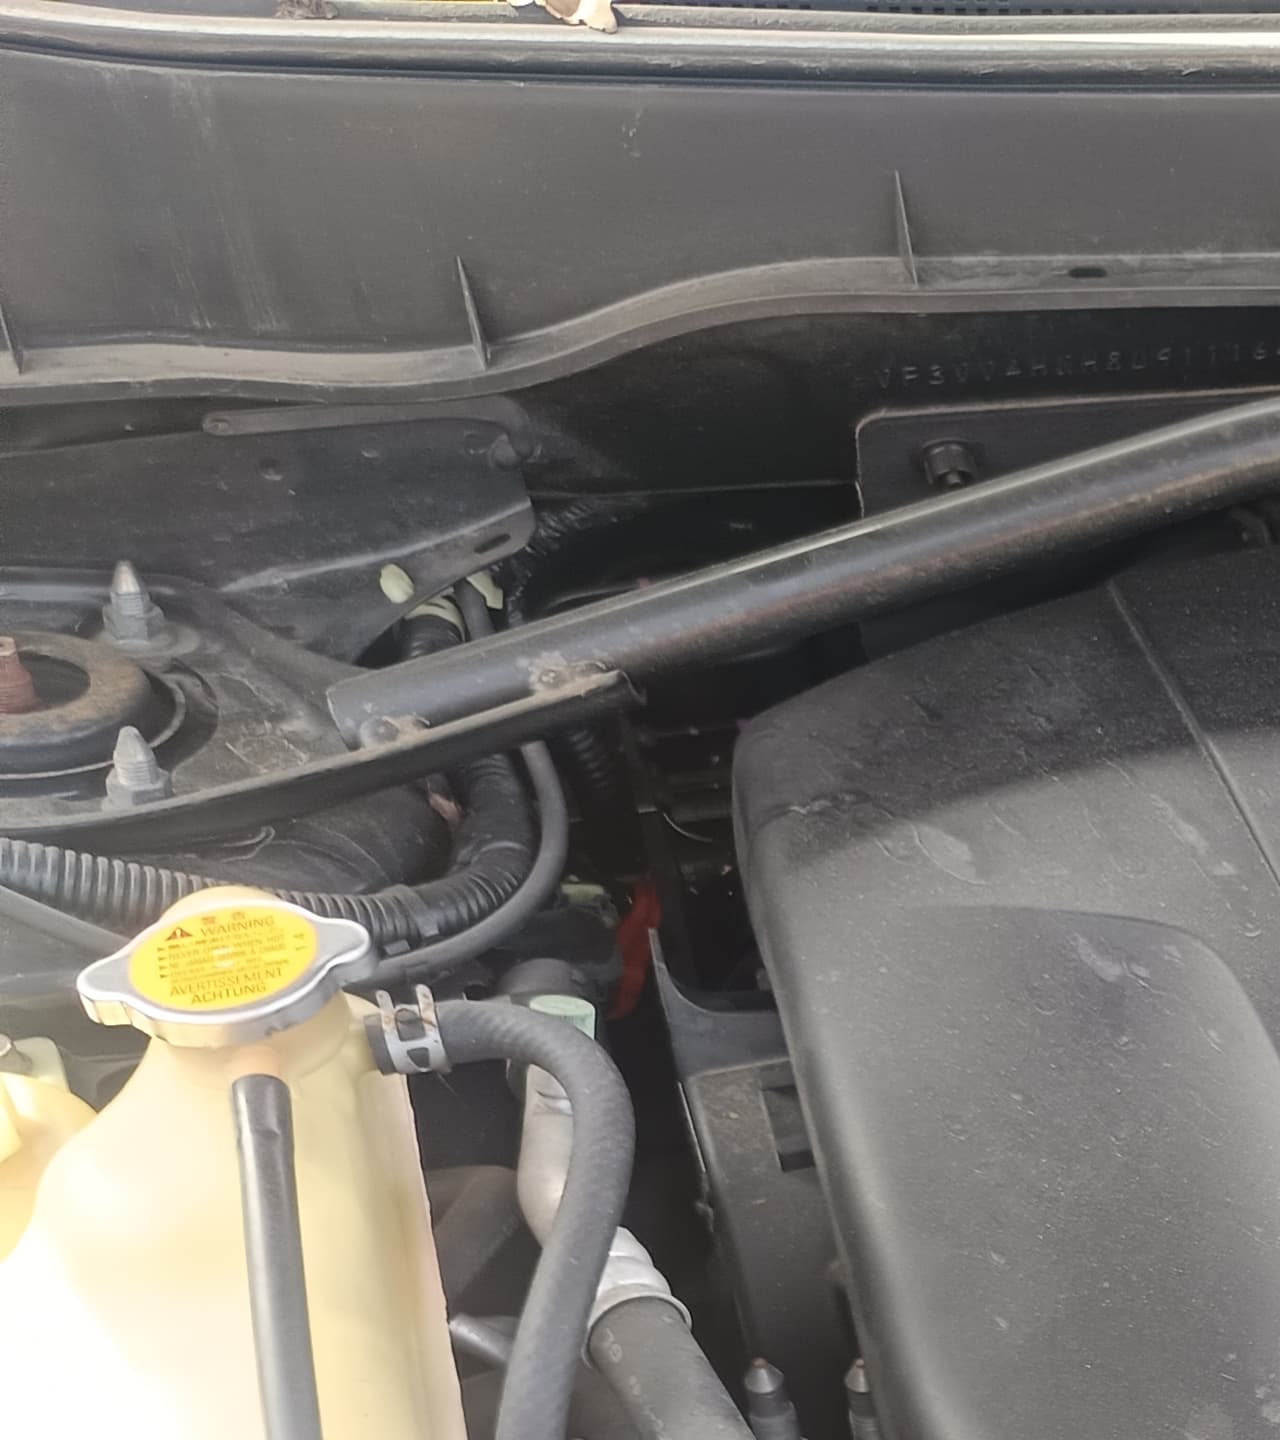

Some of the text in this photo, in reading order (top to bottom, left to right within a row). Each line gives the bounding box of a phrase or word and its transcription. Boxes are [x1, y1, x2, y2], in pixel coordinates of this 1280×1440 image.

[200, 915, 274, 937] WARNING
[170, 967, 283, 997] AVERTISSEMENT
[191, 982, 267, 1004] ACHTUNG
